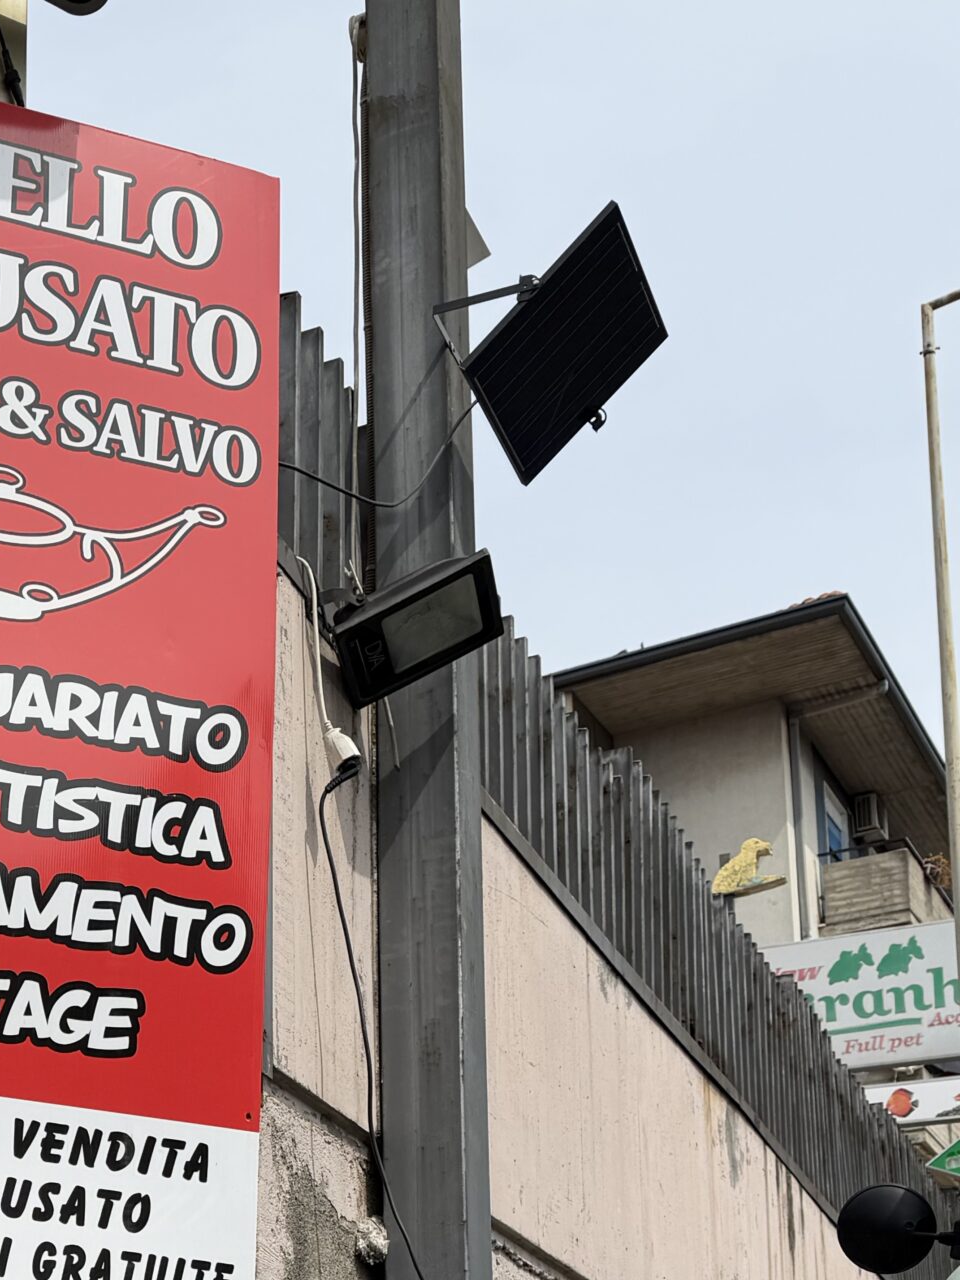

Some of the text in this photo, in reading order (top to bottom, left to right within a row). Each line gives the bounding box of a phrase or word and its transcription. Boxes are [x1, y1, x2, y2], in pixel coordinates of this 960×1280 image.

[58, 394, 260, 486] SALVO
[803, 967, 960, 1023] ranh
[842, 1032, 924, 1056] Full pet
[12, 1117, 211, 1184] VENDITA
[0, 1178, 152, 1234] USATO
